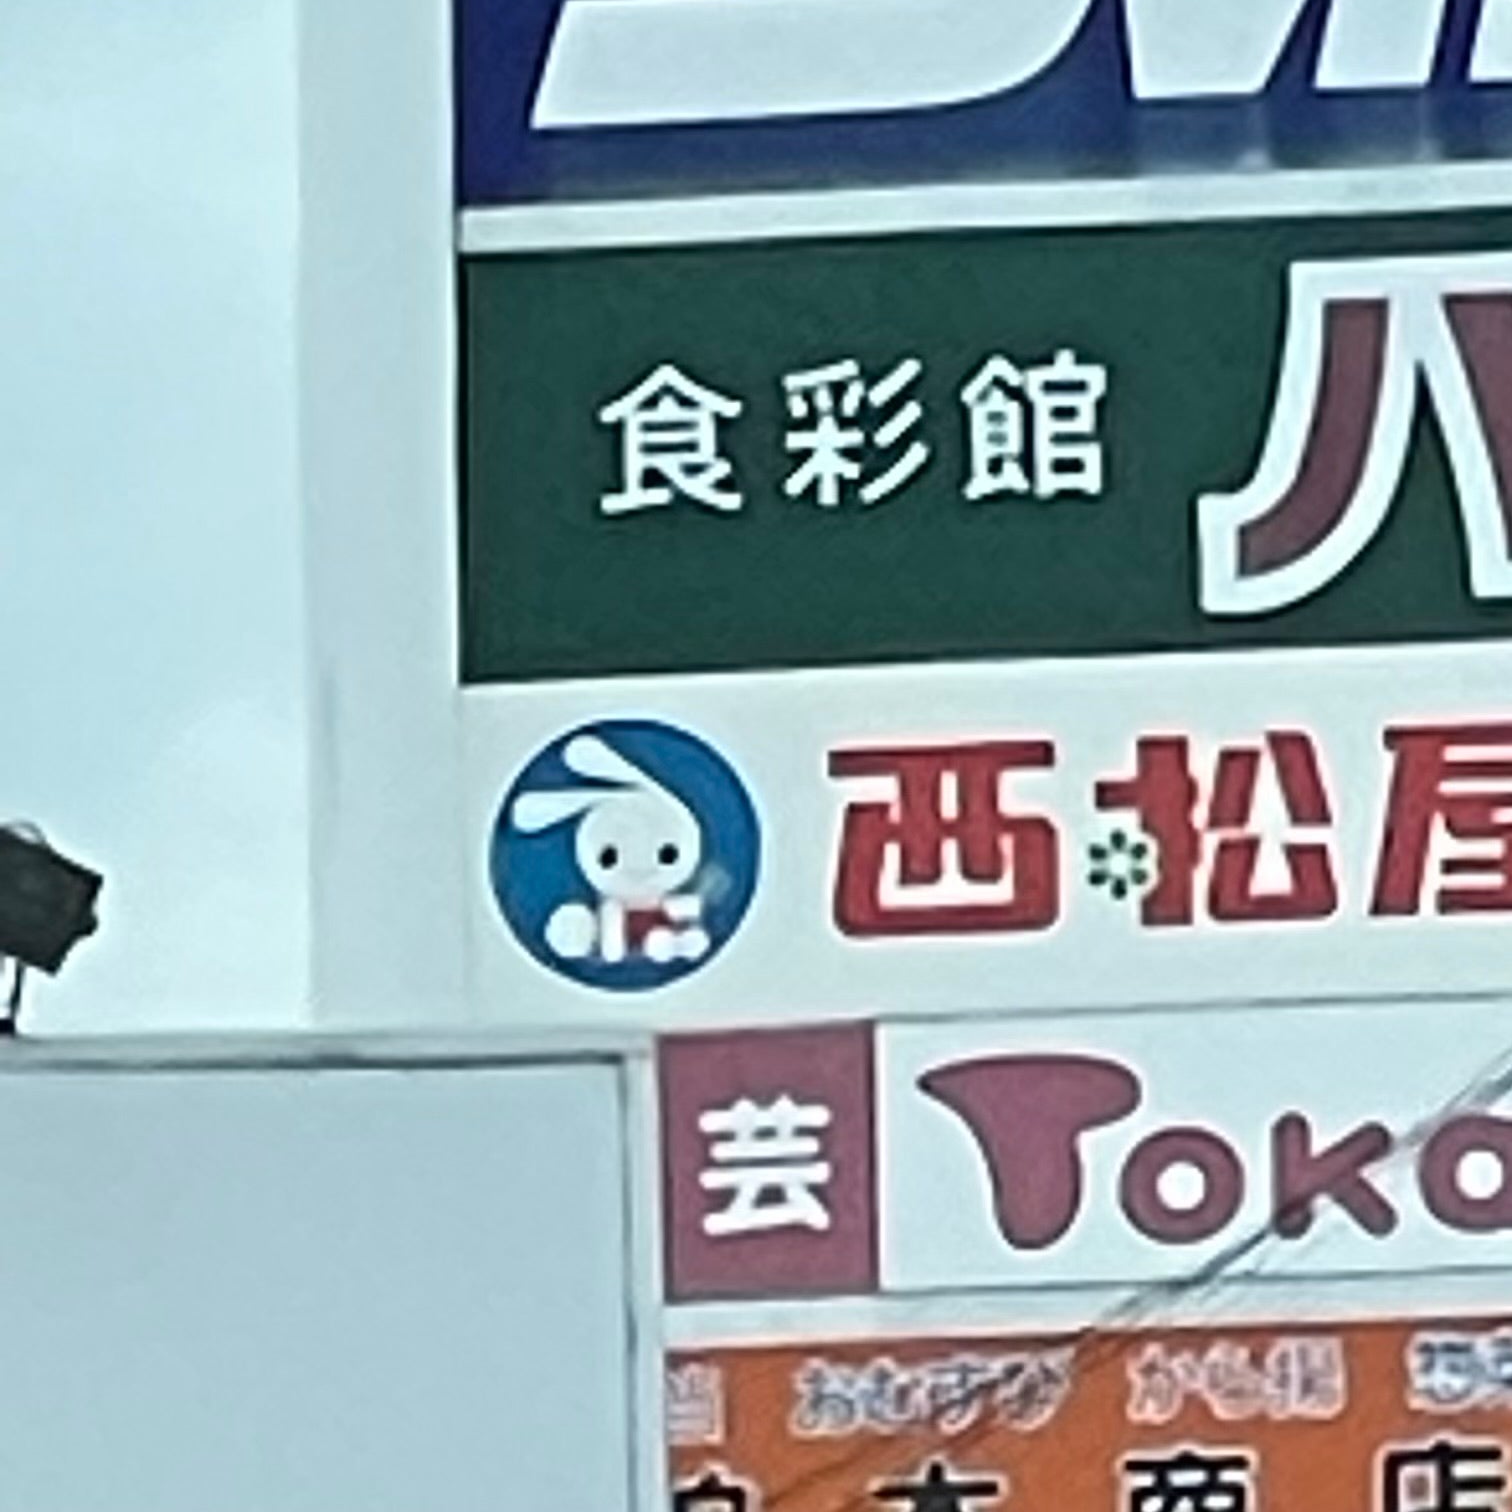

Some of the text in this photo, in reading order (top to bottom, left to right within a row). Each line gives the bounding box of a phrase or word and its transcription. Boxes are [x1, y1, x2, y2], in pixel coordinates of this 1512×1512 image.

[594, 354, 1112, 518] 食彩館
[697, 1096, 832, 1238] 芸
